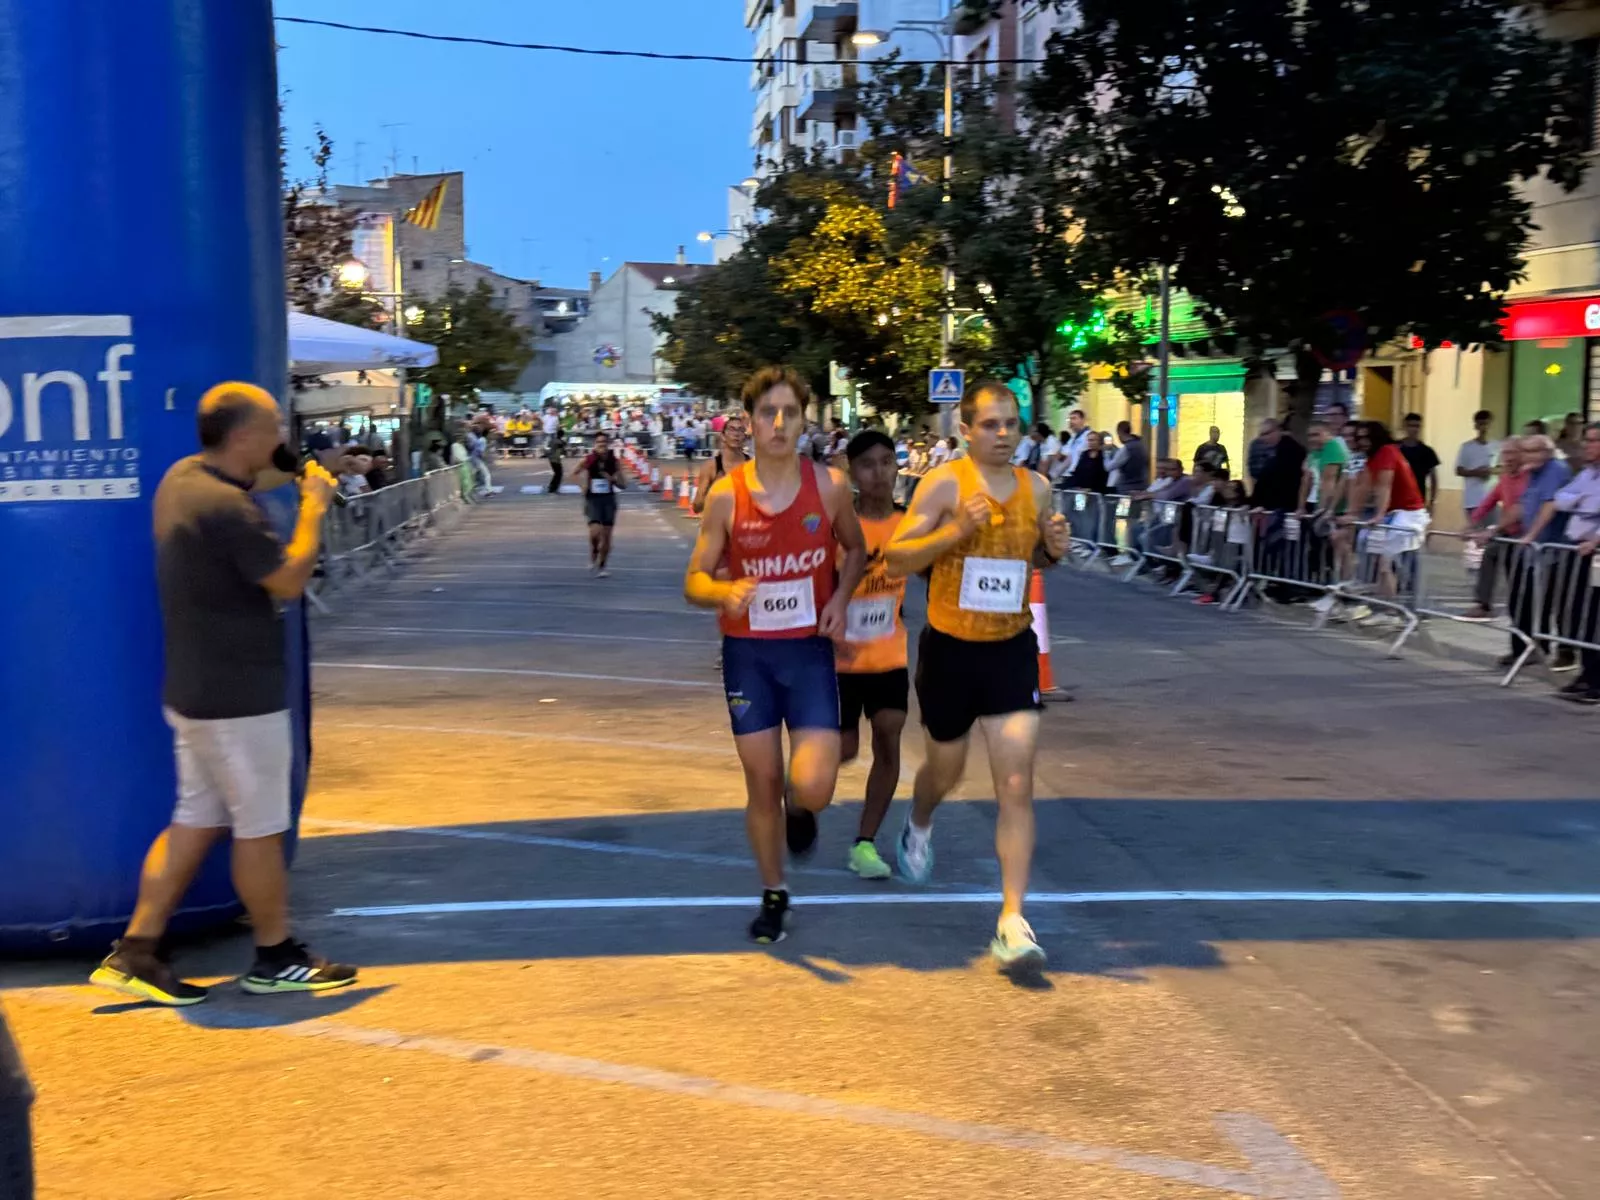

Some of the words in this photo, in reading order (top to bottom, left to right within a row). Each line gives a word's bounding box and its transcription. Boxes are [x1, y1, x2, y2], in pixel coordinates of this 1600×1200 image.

[0, 343, 136, 442] nf
[978, 575, 1011, 593] 624
[763, 596, 798, 613] 660
